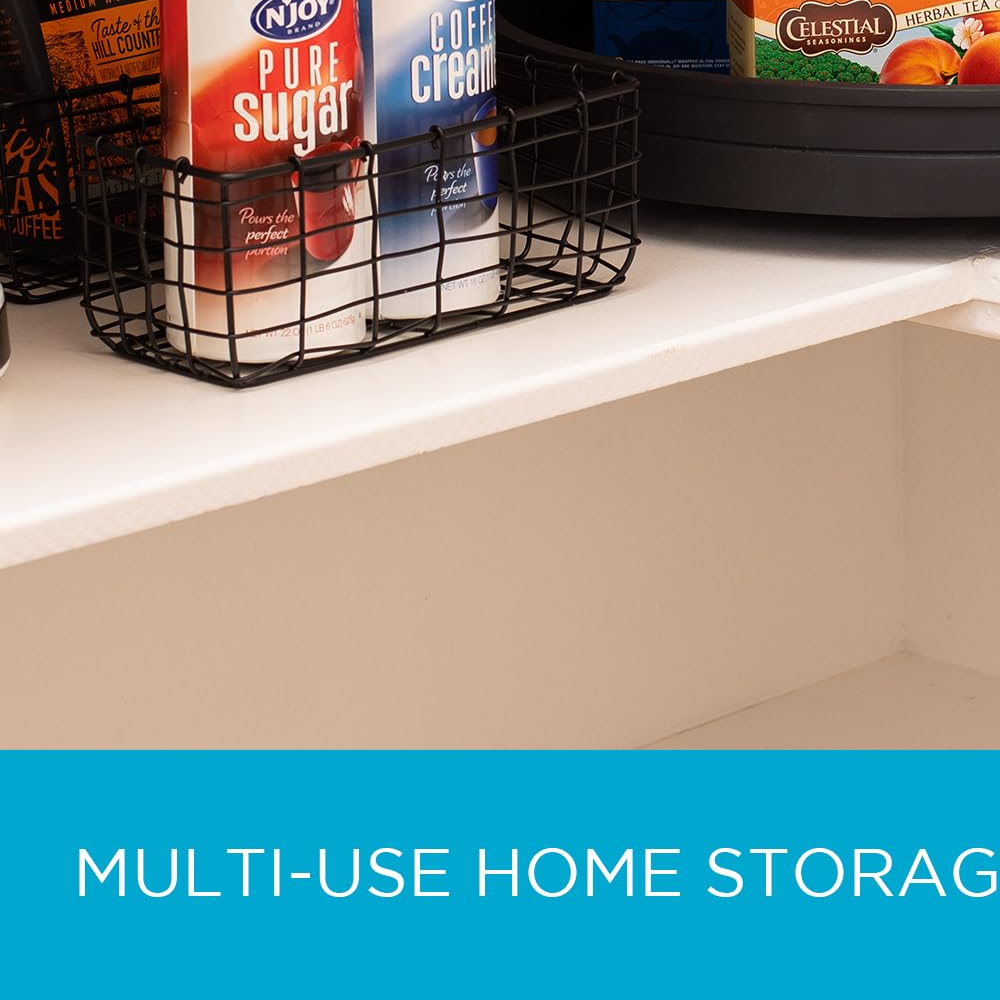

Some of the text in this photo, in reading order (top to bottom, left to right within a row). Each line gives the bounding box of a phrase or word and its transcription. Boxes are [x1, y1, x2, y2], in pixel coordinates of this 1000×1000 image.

[904, 5, 960, 26] HERBAL
[962, 0, 990, 14] TEA
[90, 16, 132, 40] Taste
[132, 14, 142, 30] of
[286, 20, 321, 35] BRAND
[786, 15, 886, 42] CELESTIAL
[91, 39, 116, 60] HILL
[806, 36, 868, 46] SEASONINGS
[258, 40, 339, 90] PURE
[410, 42, 497, 104] cream
[233, 80, 353, 158] sugar
[456, 163, 472, 179] the
[238, 207, 295, 225] Pours the
[245, 224, 289, 245] perfect
